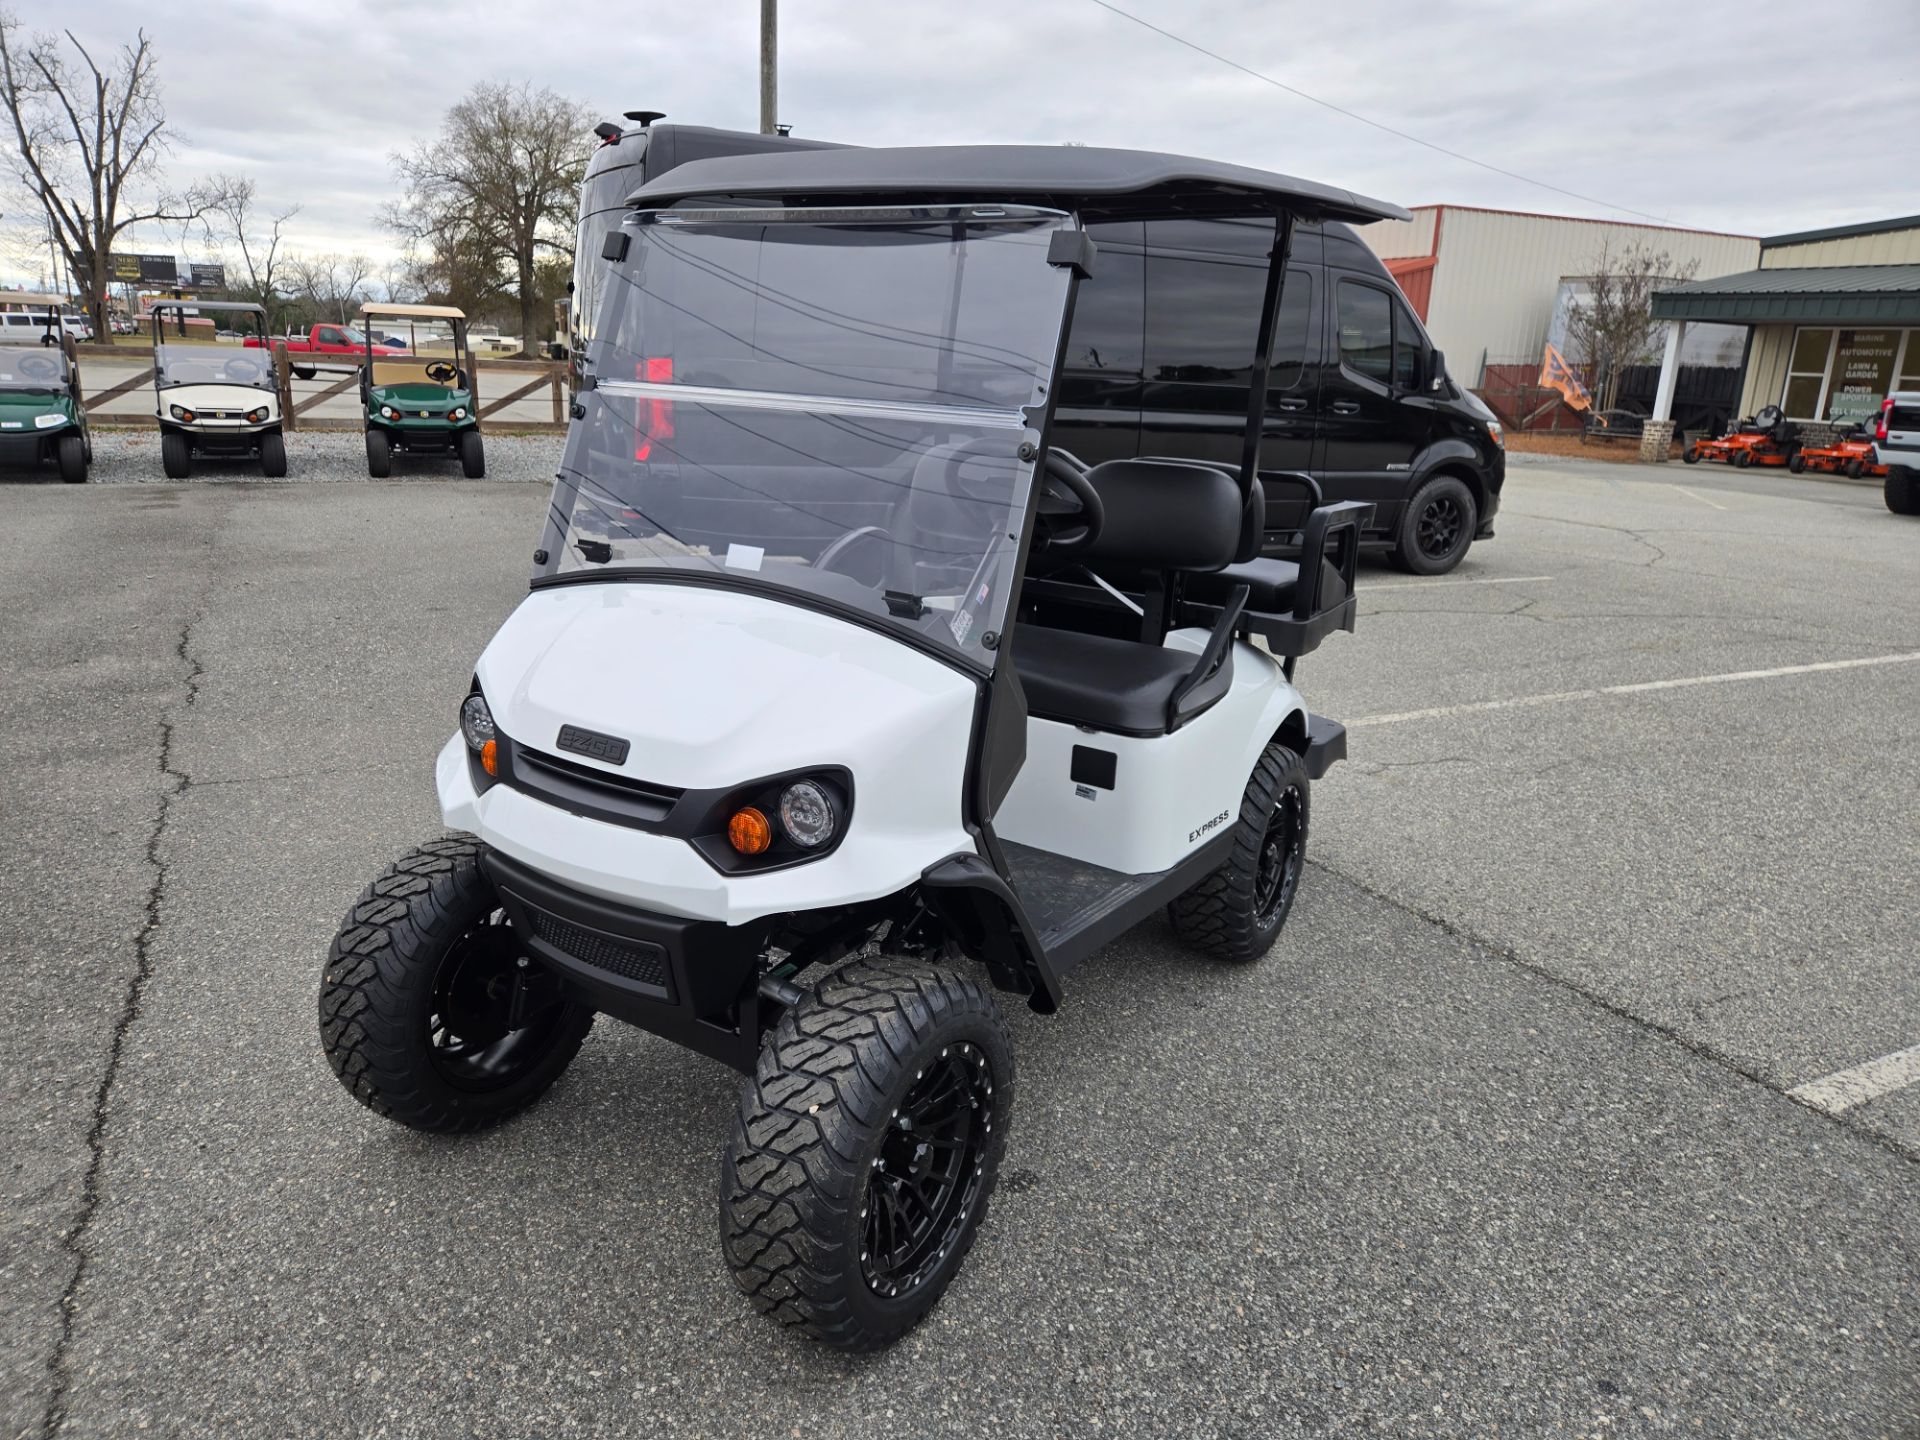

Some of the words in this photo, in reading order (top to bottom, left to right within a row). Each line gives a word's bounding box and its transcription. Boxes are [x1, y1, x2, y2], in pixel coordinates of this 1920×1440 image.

[1848, 362, 1870, 370] LAWN
[1845, 370, 1879, 379] GARDEN
[1843, 385, 1872, 393] POWER
[1840, 393, 1872, 402] SPORTS
[1829, 407, 1848, 416] CELL
[1189, 810, 1229, 843] EXPRESS
